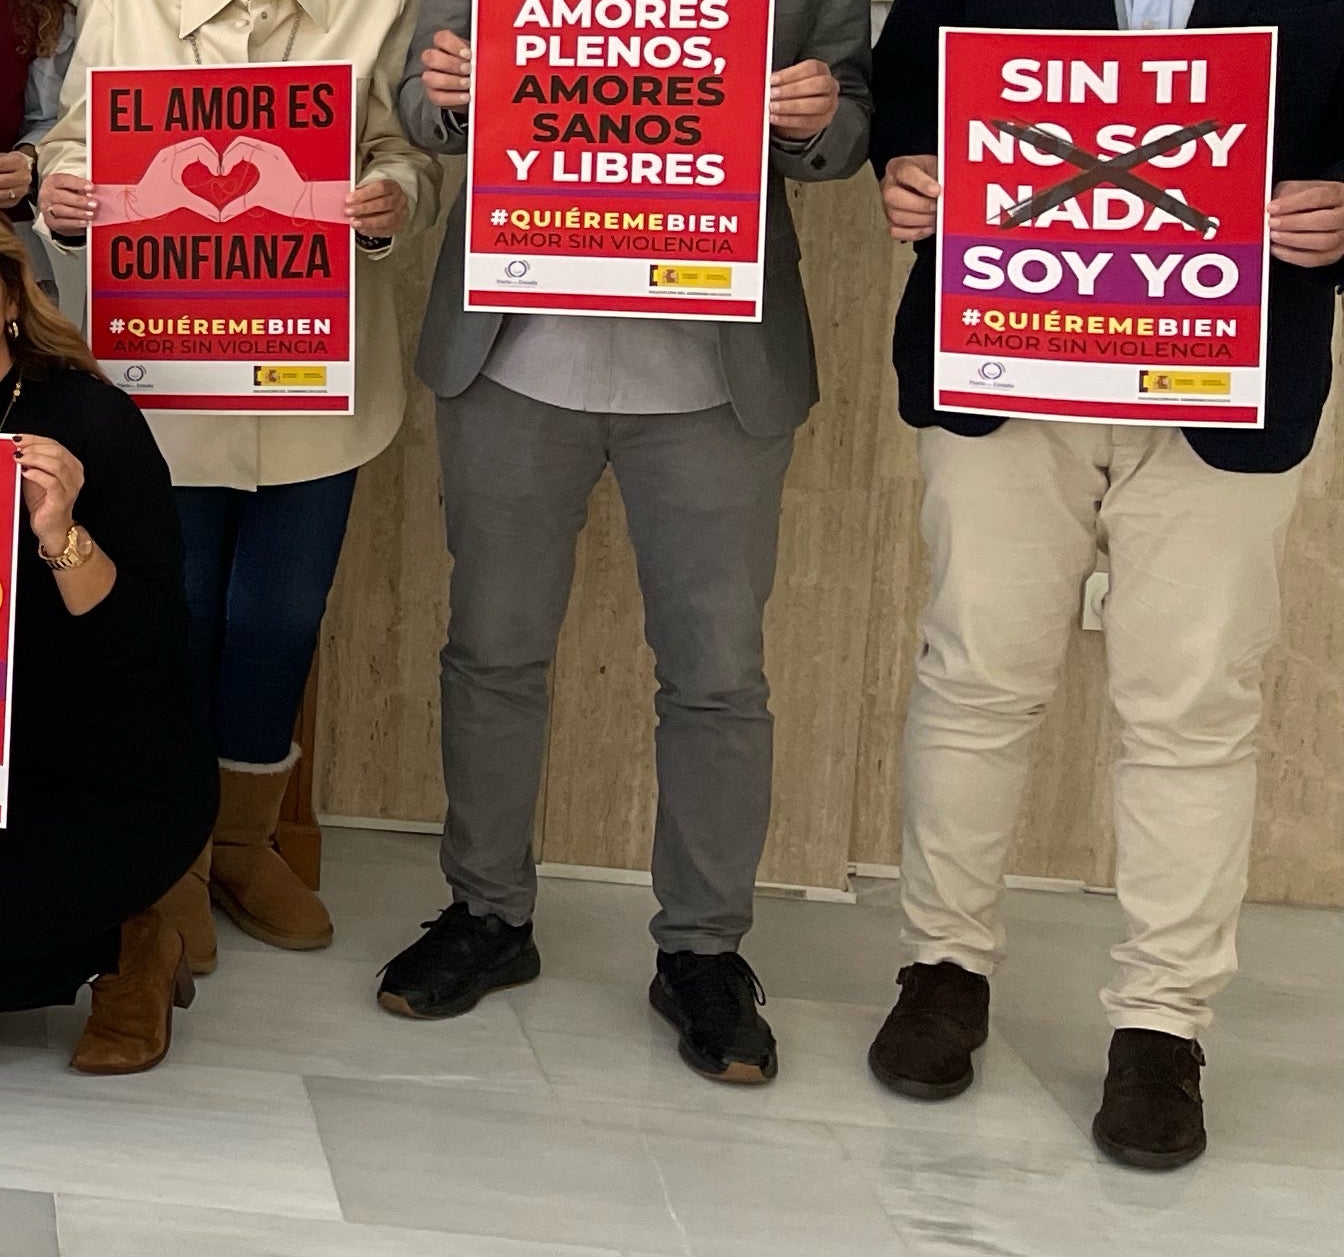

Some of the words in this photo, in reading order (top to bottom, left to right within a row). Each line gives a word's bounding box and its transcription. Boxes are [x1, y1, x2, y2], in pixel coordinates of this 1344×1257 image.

[516, 35, 726, 75] PLENOS,
[512, 75, 726, 106] AMORES
[1000, 58, 1119, 104] SIN
[1142, 59, 1208, 104] TI
[110, 88, 153, 132] EL
[164, 85, 275, 131] AMOR
[289, 83, 334, 128] ES
[532, 113, 701, 145] SANOS
[967, 120, 1073, 165] NO
[1096, 123, 1247, 168] SOY
[507, 150, 540, 181] Y
[553, 151, 726, 186] LIBRES
[490, 207, 738, 233] #QUIÉREMEBIEN
[110, 233, 331, 280] CONFIANZA
[494, 232, 562, 249] AMOR
[569, 232, 603, 250] SIN
[611, 235, 734, 255] VIOLENCIA
[962, 245, 1114, 295] SOY
[1131, 253, 1240, 299] YO
[109, 315, 331, 336] #QUIÉREMEBIEN
[962, 308, 1237, 337] #QUIÉREMEBIEN
[113, 339, 173, 355] AMOR
[180, 339, 212, 355] SIN
[219, 339, 329, 355] VIOLENCIA
[965, 332, 1041, 351] AMOR
[1048, 334, 1086, 353] SIN
[1095, 338, 1232, 358] VIOLENCIA
